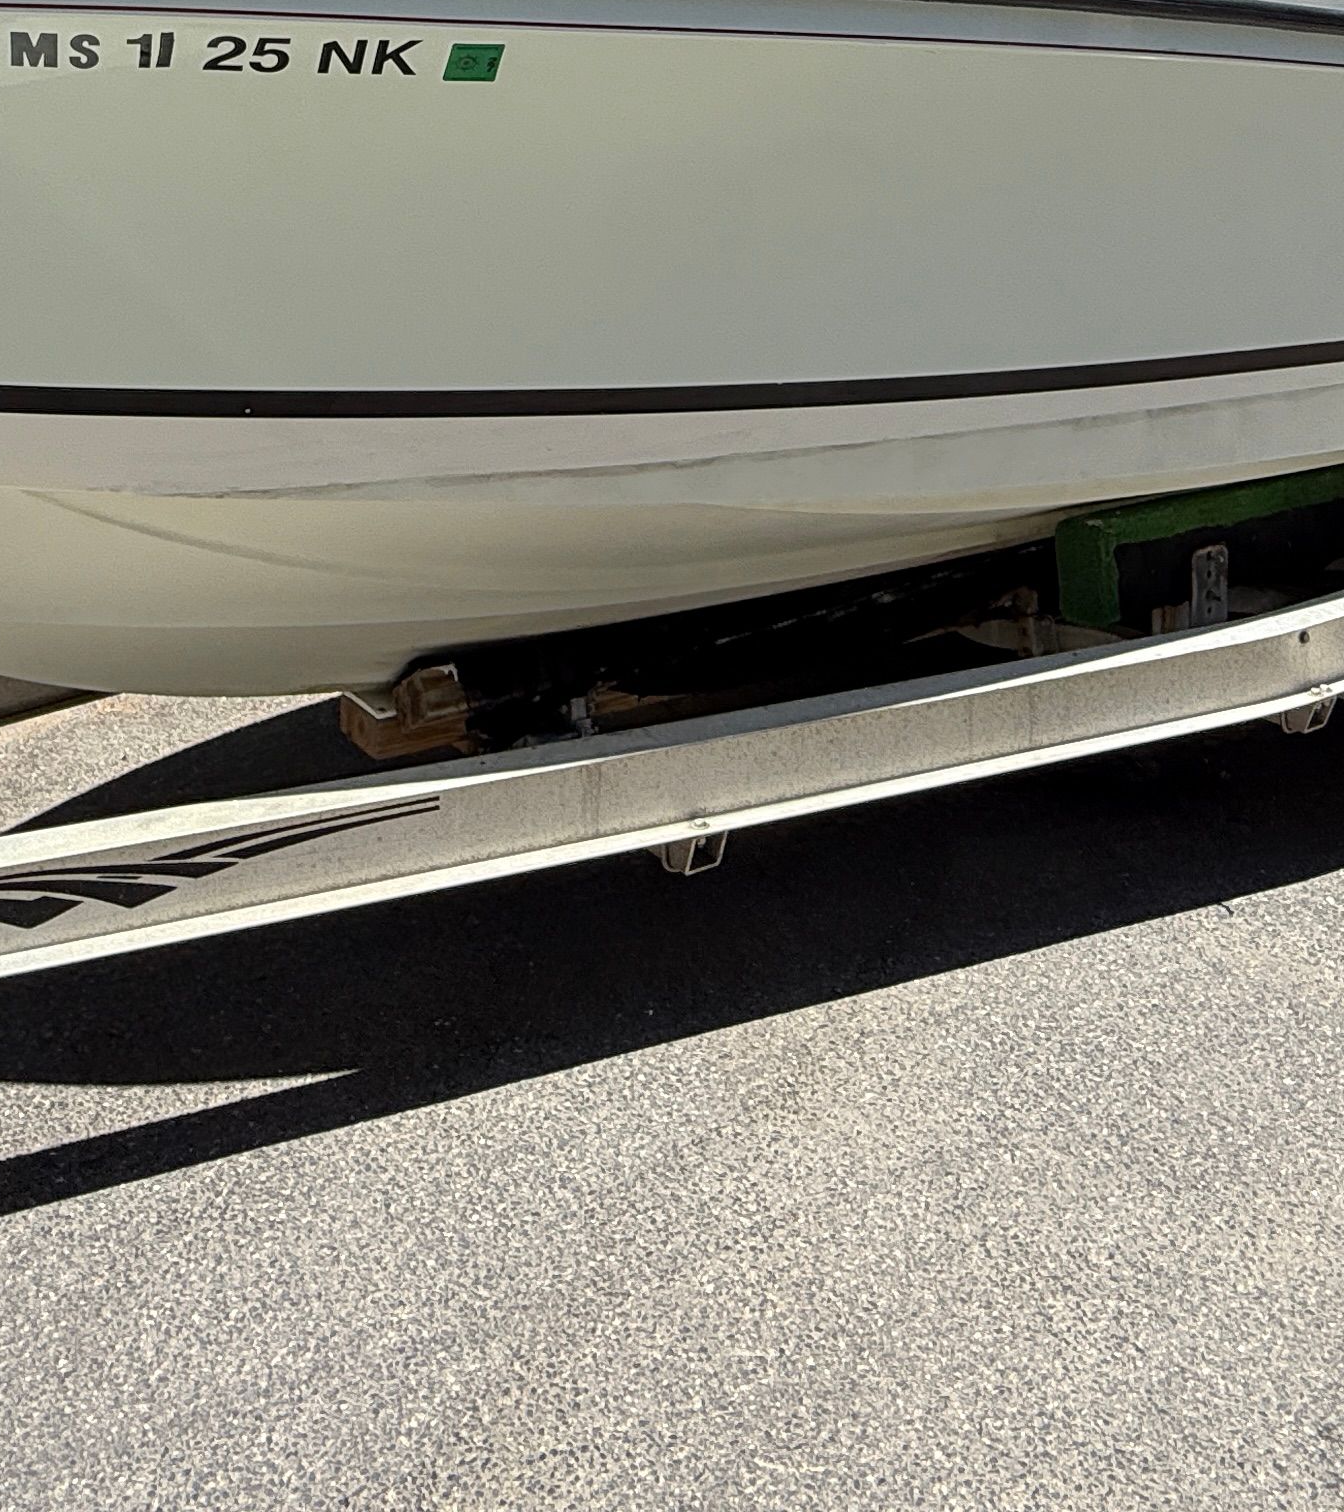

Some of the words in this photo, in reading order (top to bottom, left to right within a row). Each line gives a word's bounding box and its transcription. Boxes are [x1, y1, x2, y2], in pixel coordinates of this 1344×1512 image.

[10, 31, 101, 70] MS
[202, 35, 291, 74] 25
[316, 39, 424, 77] NK
